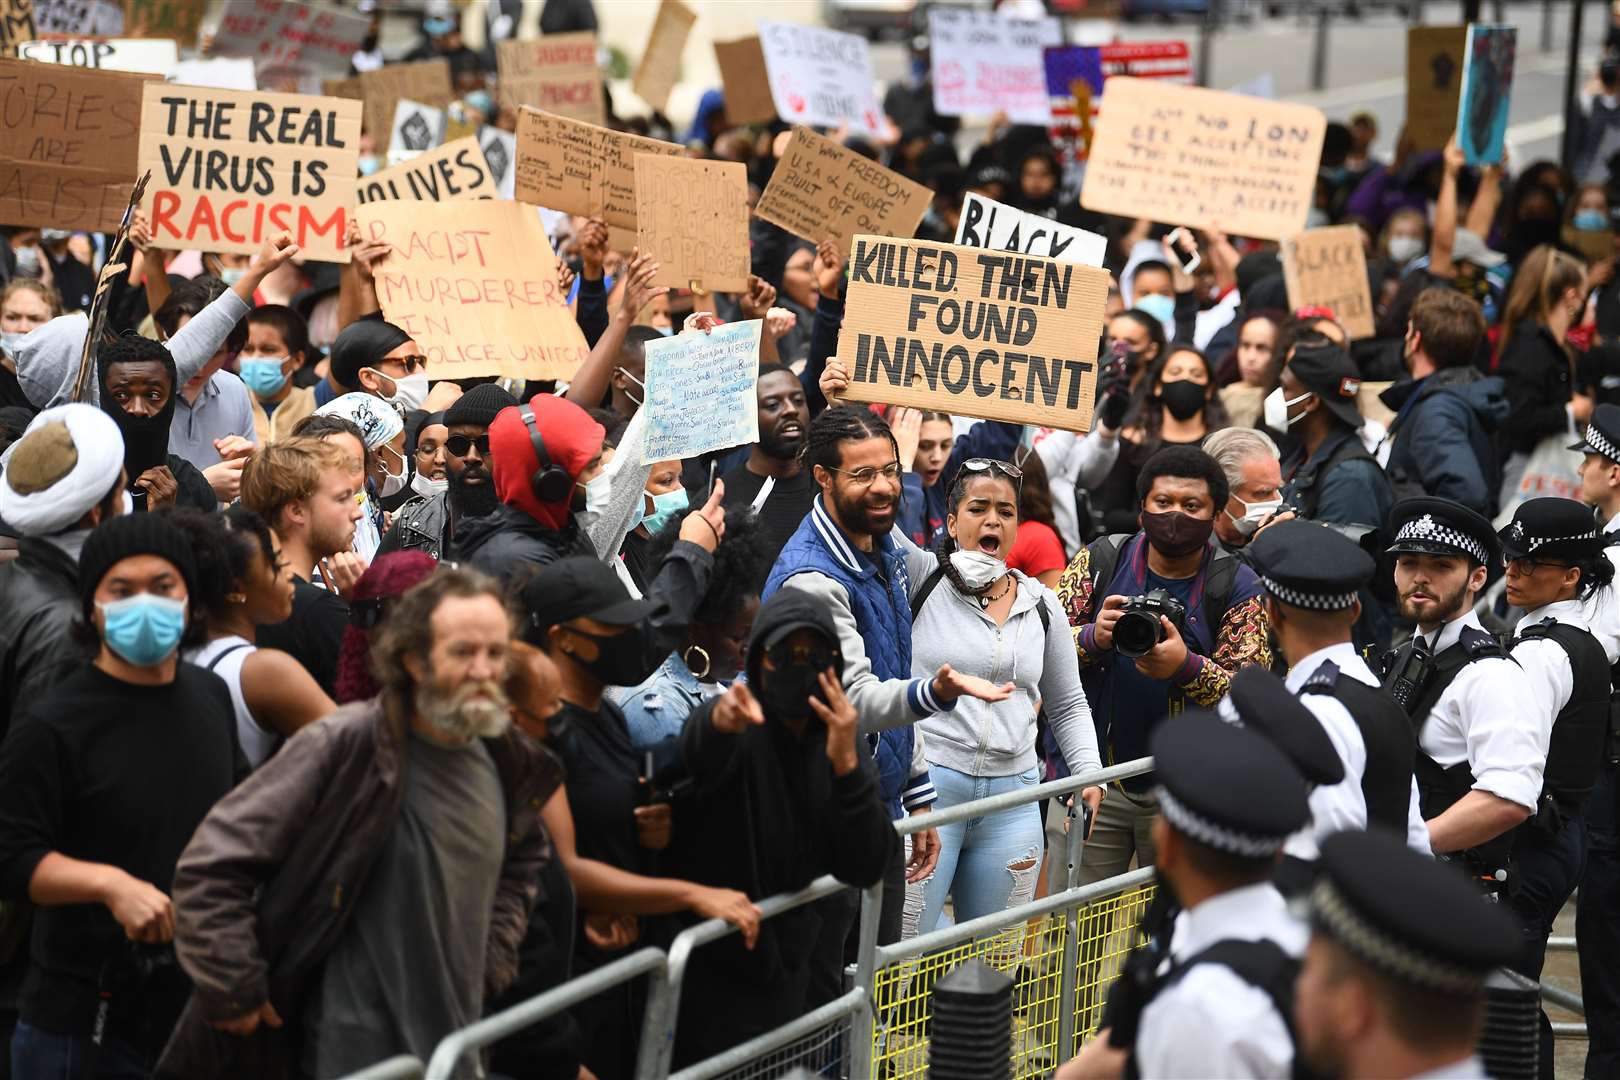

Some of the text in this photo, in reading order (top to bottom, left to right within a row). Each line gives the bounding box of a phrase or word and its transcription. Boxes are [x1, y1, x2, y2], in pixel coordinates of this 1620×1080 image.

[23, 43, 115, 68] STOP
[161, 97, 346, 149] THE REAL
[597, 131, 622, 147] THE
[628, 138, 662, 154] LEGACY
[29, 136, 84, 165] ARE
[160, 144, 275, 197] VIRUS
[291, 160, 328, 197] IS
[797, 129, 816, 149] WE
[818, 144, 845, 162] WANT
[847, 158, 912, 204] FREEDOM
[783, 170, 822, 197] BUILT
[827, 195, 854, 217] OFF
[843, 182, 895, 220] EUROPE
[151, 190, 347, 250] RACISM
[959, 198, 1075, 258] BLACK
[977, 254, 1073, 310] THEN
[395, 314, 452, 336] IN
[907, 293, 1038, 347] FOUND
[852, 333, 1093, 410] INNOCENT
